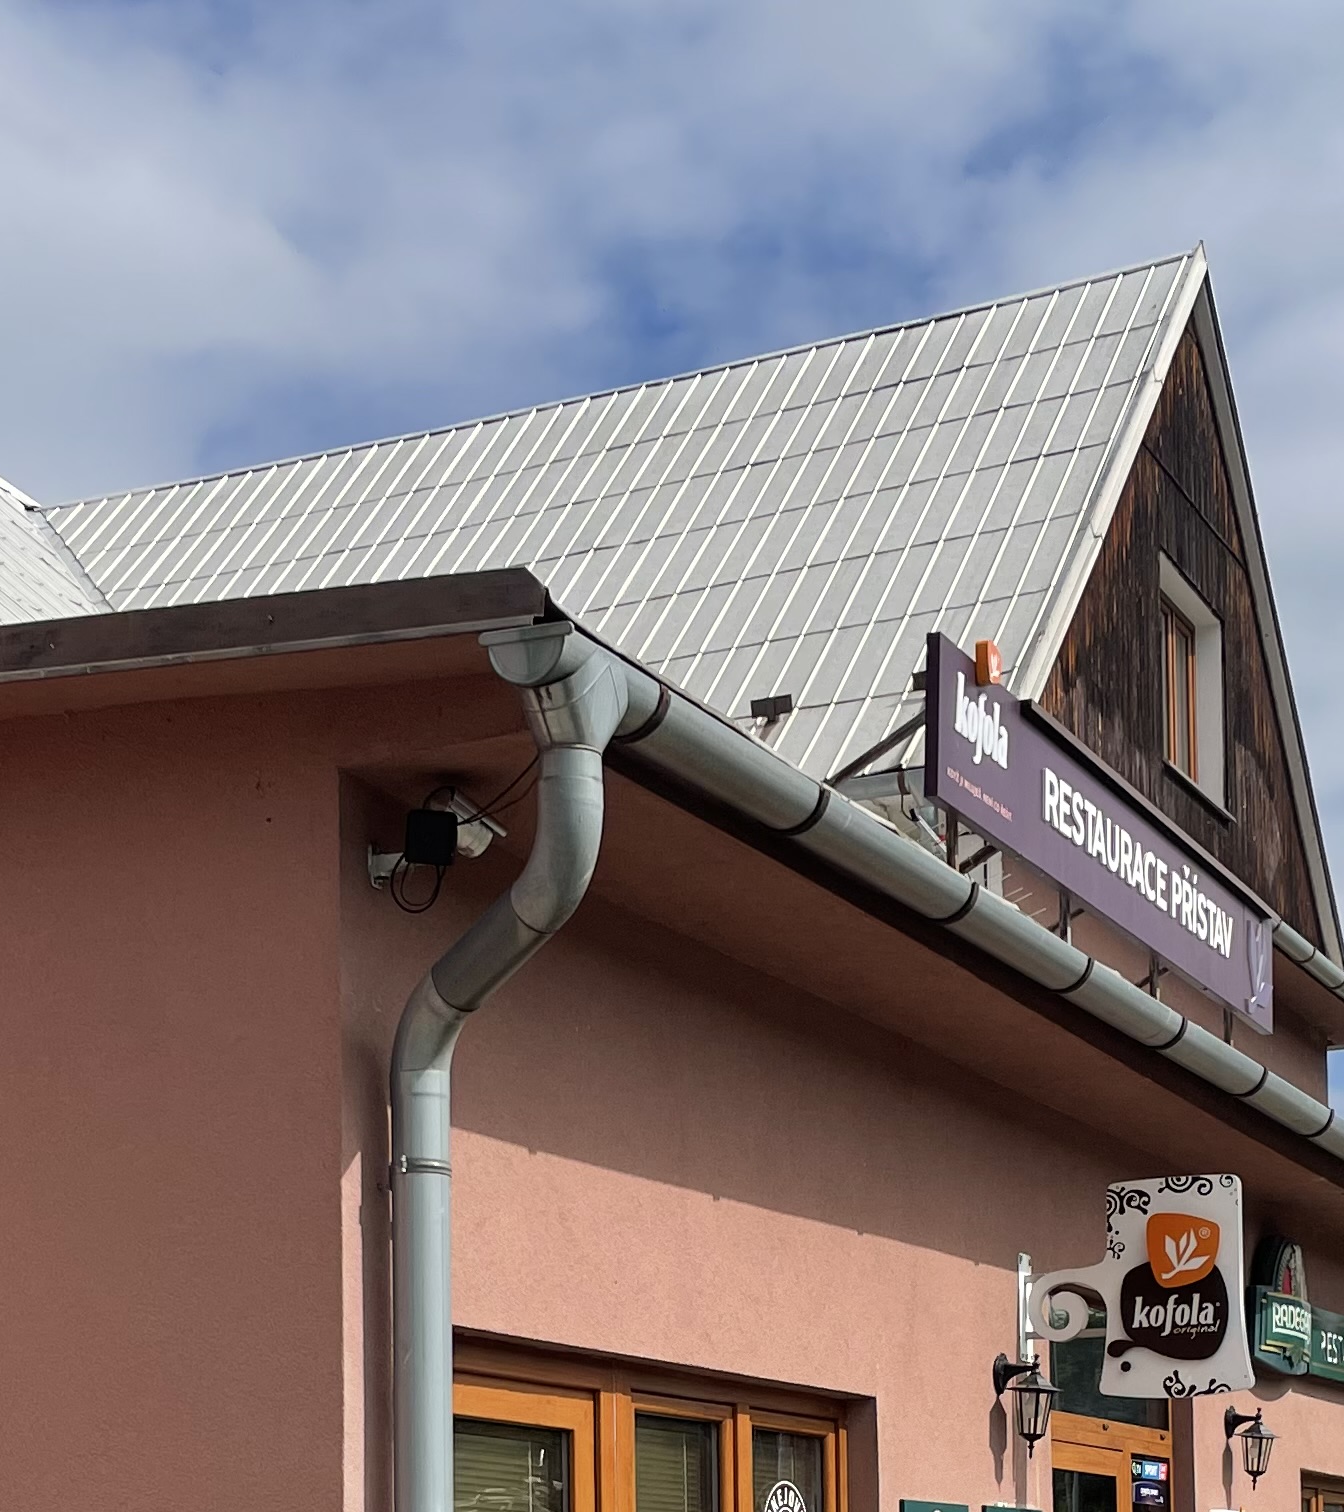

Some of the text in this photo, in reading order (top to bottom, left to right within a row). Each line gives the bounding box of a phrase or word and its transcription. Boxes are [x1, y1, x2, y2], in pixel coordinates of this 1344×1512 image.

[953, 671, 1009, 769] kofola
[1041, 766, 1168, 912] RESTAURACE
[1169, 864, 1236, 960] PŘÍSTAV
[1132, 1292, 1215, 1336] kofola
[1173, 1319, 1221, 1339] original
